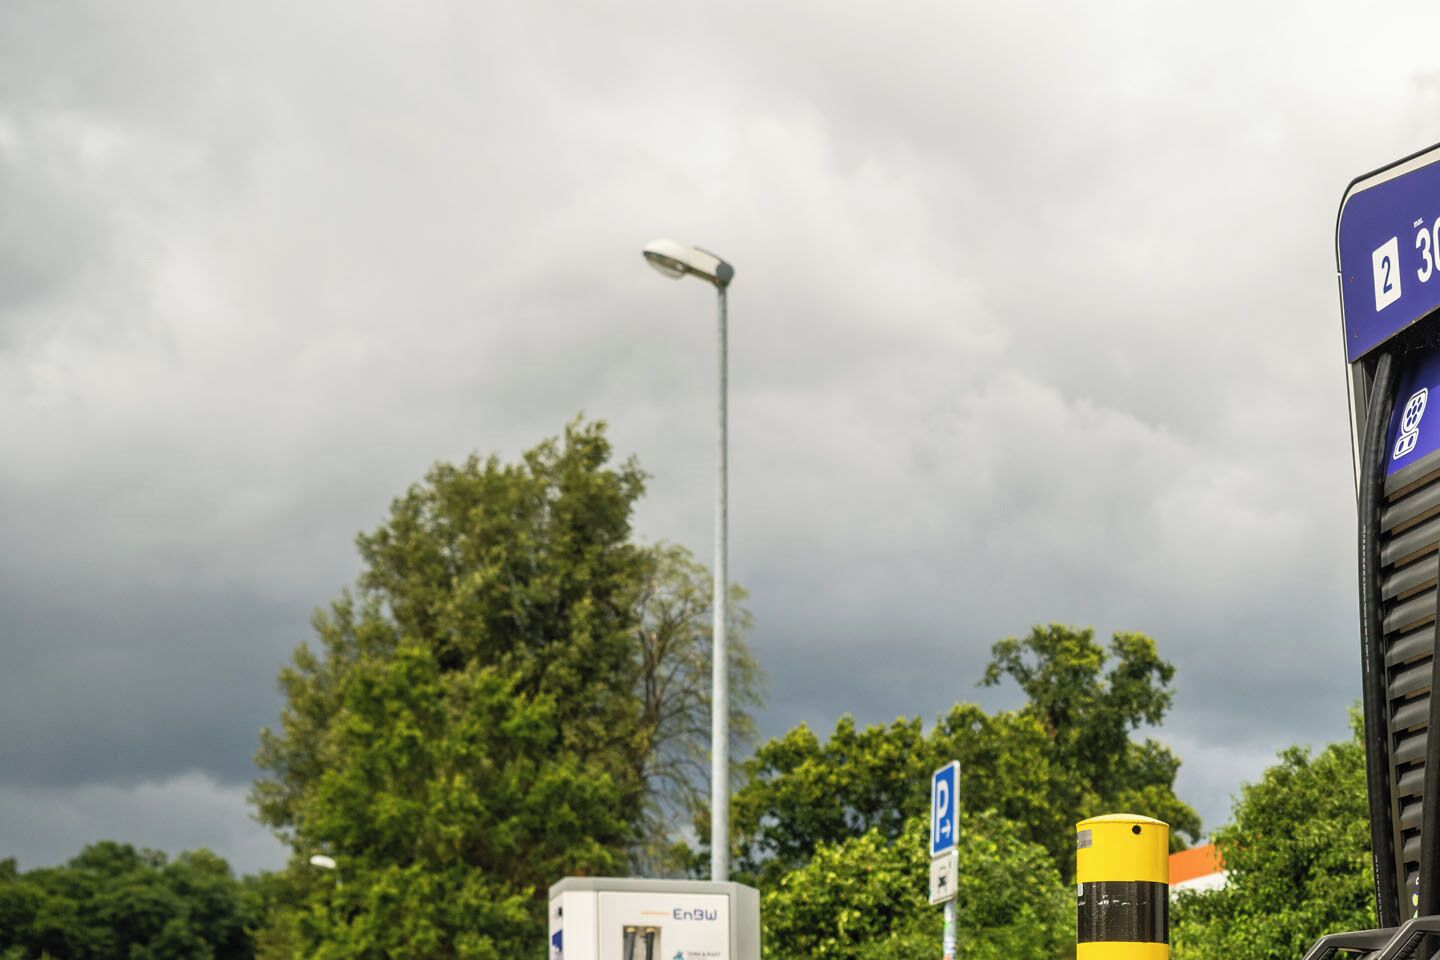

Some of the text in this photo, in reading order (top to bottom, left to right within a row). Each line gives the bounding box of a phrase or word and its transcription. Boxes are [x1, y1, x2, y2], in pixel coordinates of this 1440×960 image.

[1381, 255, 1393, 295] 2
[935, 779, 950, 844] P
[673, 908, 718, 921] EnBW
